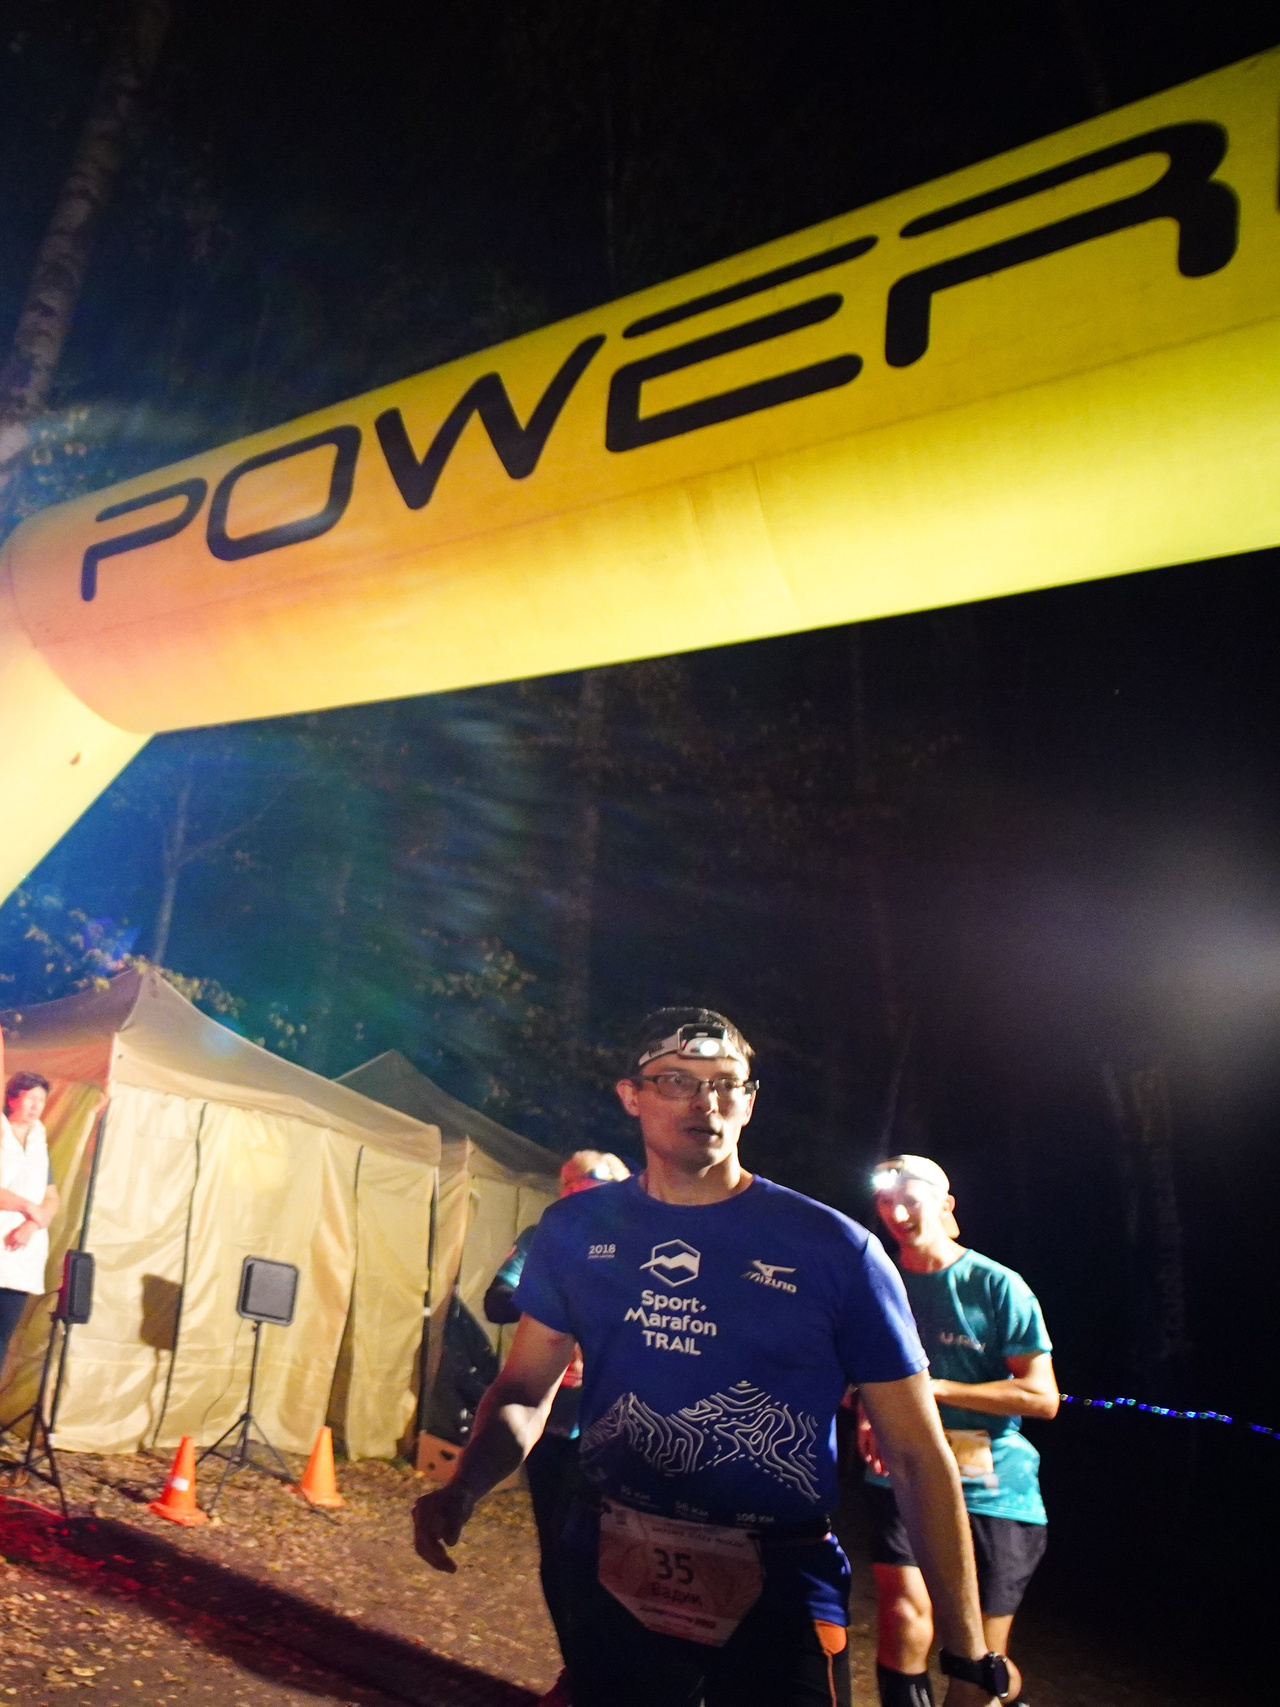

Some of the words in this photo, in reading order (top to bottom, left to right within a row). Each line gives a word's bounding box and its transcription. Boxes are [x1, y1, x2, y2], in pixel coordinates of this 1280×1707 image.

[81, 110, 1280, 601] POWER
[589, 1243, 617, 1255] 2018
[623, 1306, 718, 1337] Marafon
[642, 1329, 702, 1356] TRAIL
[655, 1548, 694, 1585] 35
